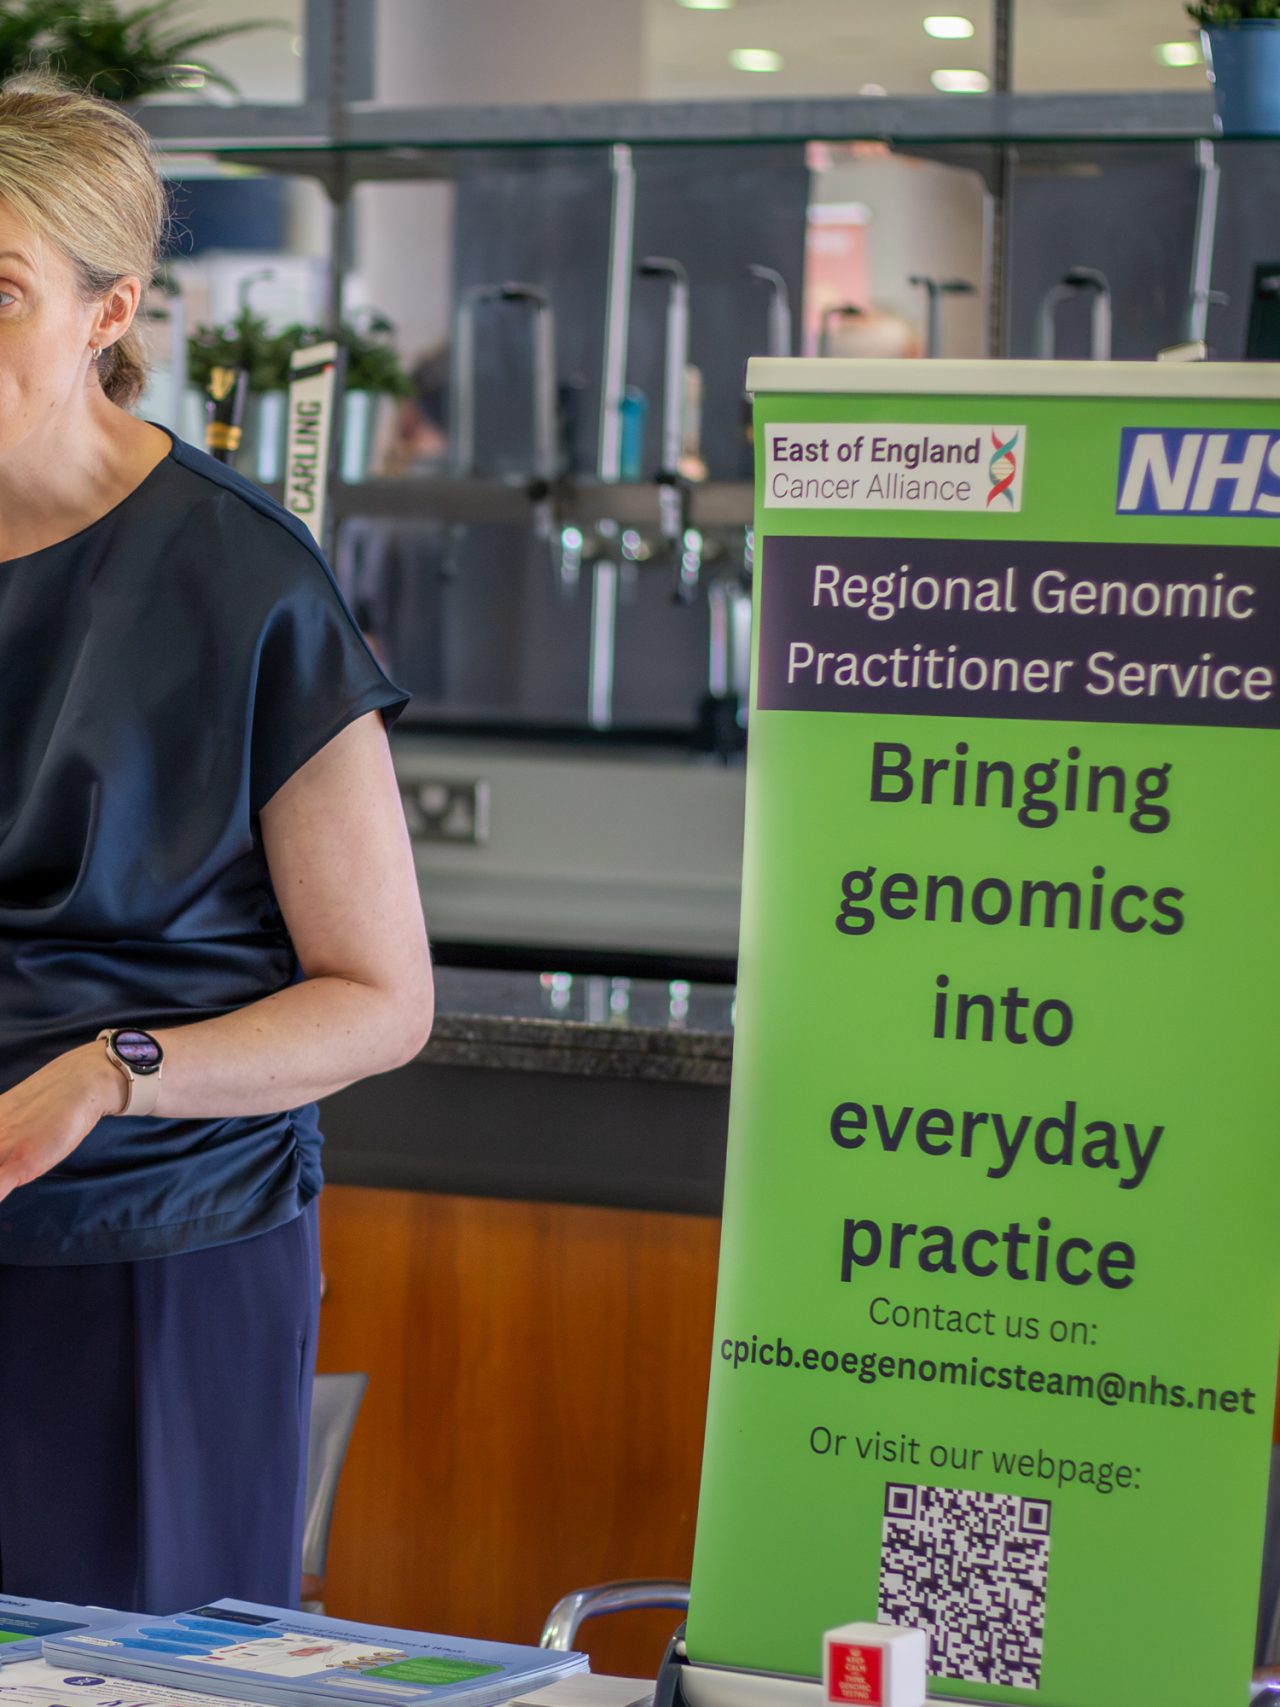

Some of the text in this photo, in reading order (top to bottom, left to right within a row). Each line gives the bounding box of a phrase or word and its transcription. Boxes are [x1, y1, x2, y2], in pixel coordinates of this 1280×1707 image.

[291, 401, 321, 513] CARLING
[772, 472, 971, 501] Cancer Alliance
[773, 436, 981, 469] East of England
[812, 564, 1255, 621] Regional Genomic
[787, 642, 1273, 701] Practitioner Service
[869, 741, 1172, 834] Bringing
[835, 865, 1186, 936] genomics
[932, 974, 1073, 1046] into
[829, 1098, 1165, 1190] everyday
[840, 1216, 1136, 1290] practice
[868, 1296, 1097, 1345] Contact us on:
[720, 1335, 1256, 1414] cpicb.eoegenomicsteam@nhs.net
[809, 1426, 1142, 1493] Or visit our webpage:
